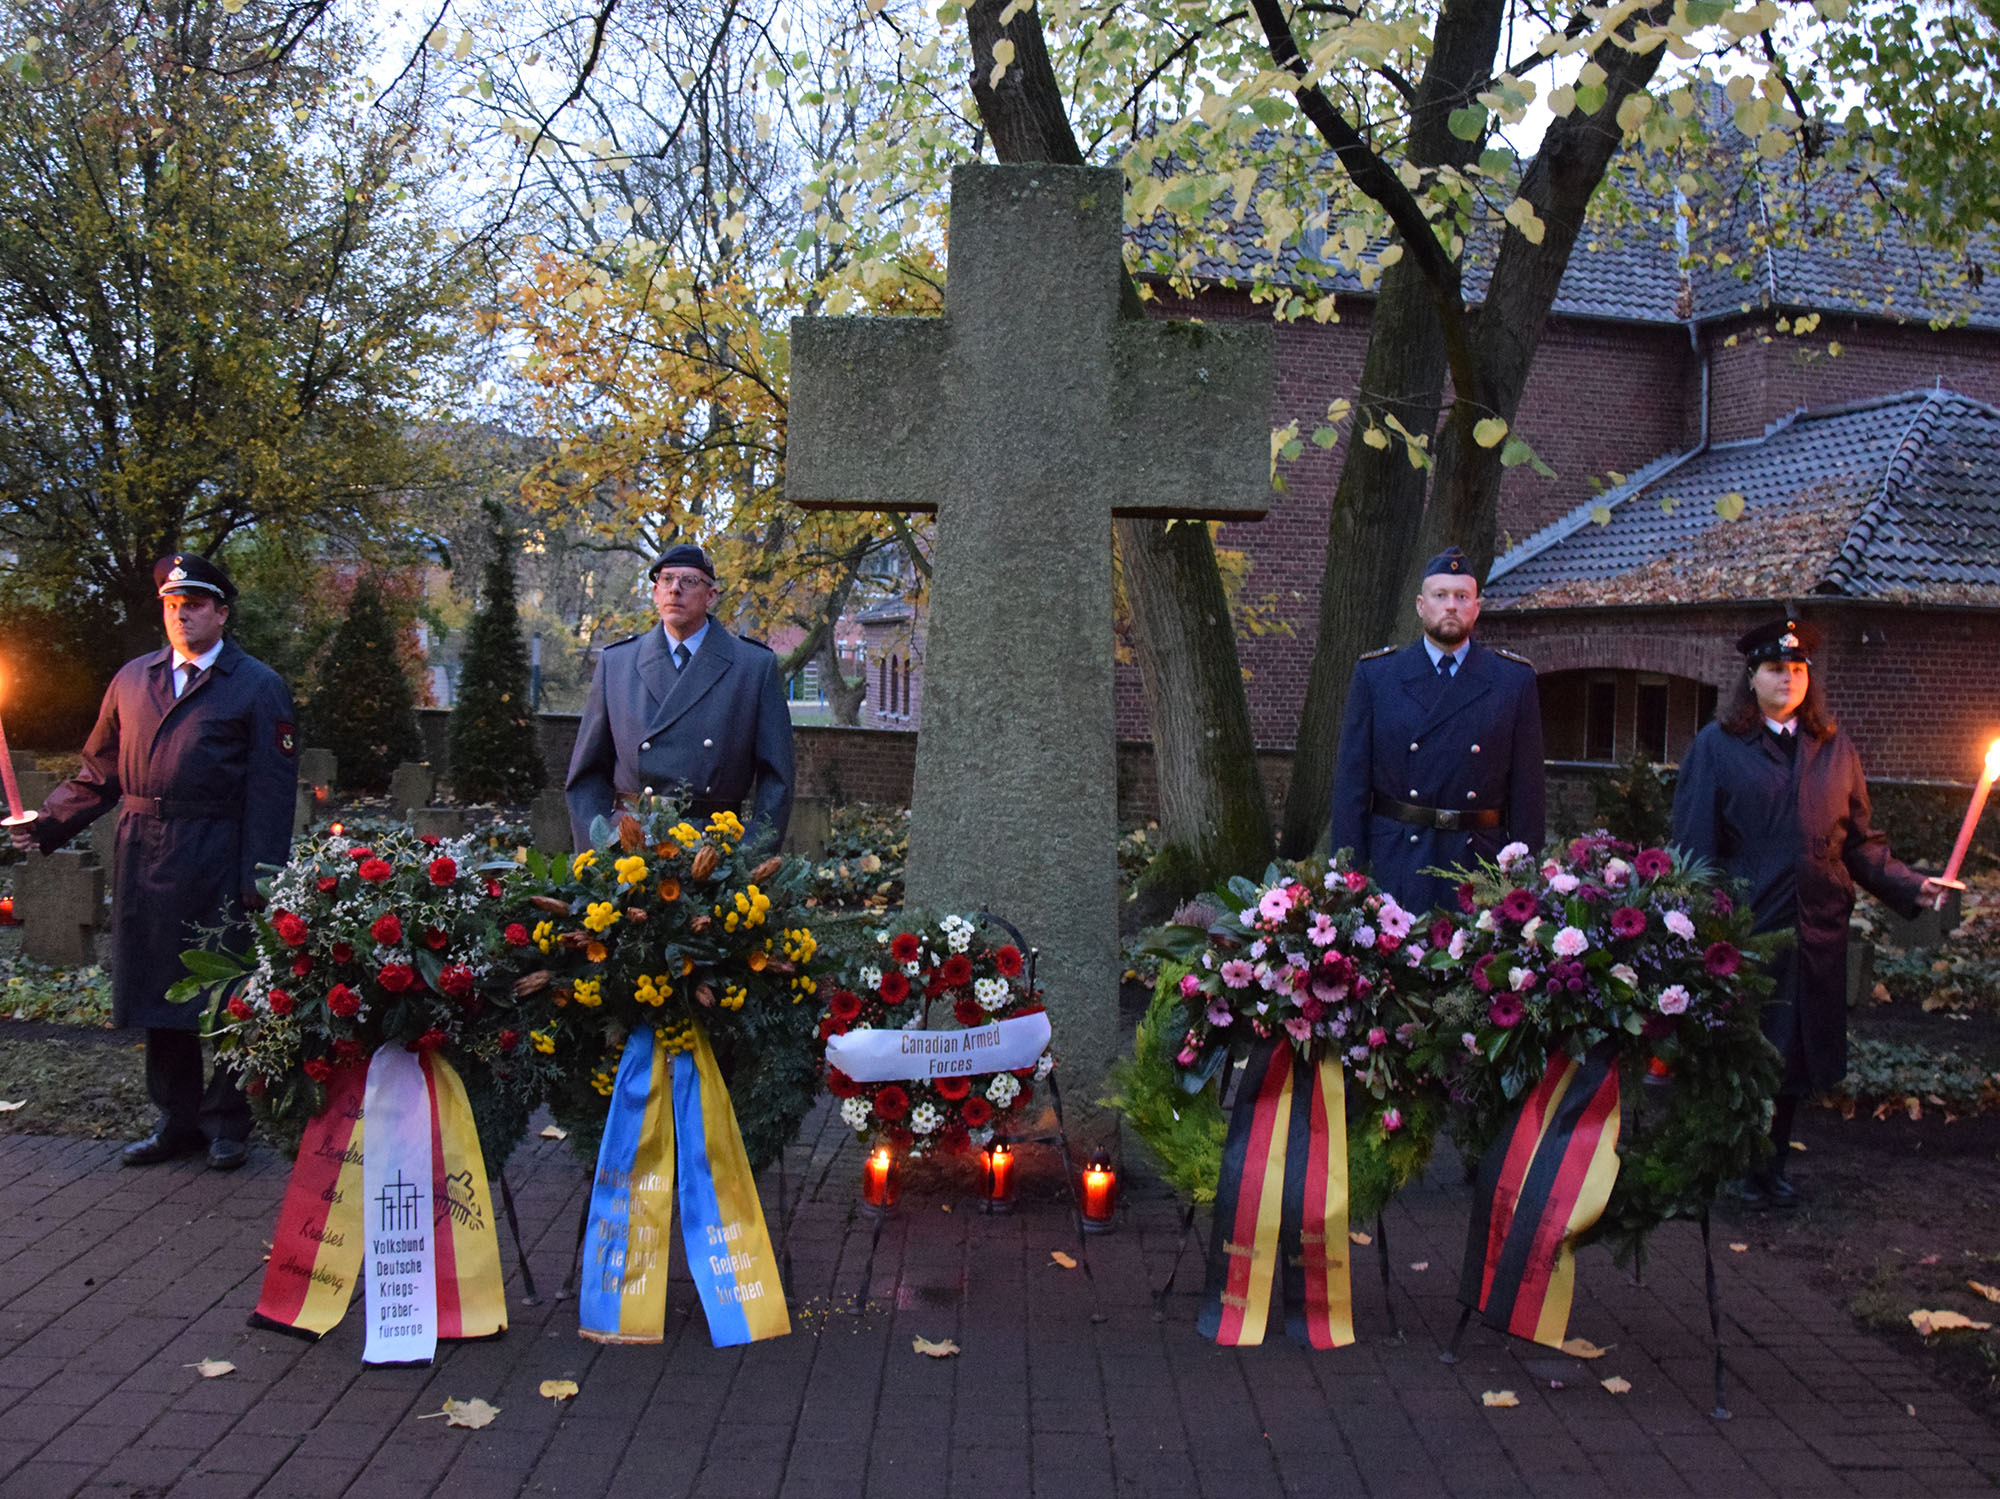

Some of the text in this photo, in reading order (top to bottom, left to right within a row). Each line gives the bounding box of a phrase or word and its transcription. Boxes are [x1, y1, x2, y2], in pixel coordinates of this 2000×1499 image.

[901, 1026, 1000, 1054] Canadian Armed
[929, 1058, 973, 1075] Forces
[342, 1095, 365, 1120] De
[315, 1134, 365, 1166] Landra
[321, 1180, 344, 1204] des
[299, 1217, 346, 1248] Kreises
[706, 1221, 743, 1246] Stadt
[373, 1236, 425, 1255] Volksbund
[376, 1259, 423, 1277] Deutsche
[380, 1281, 420, 1299] Kriegs-
[380, 1302, 420, 1321] gräber-
[379, 1323, 423, 1339] fürsorge
